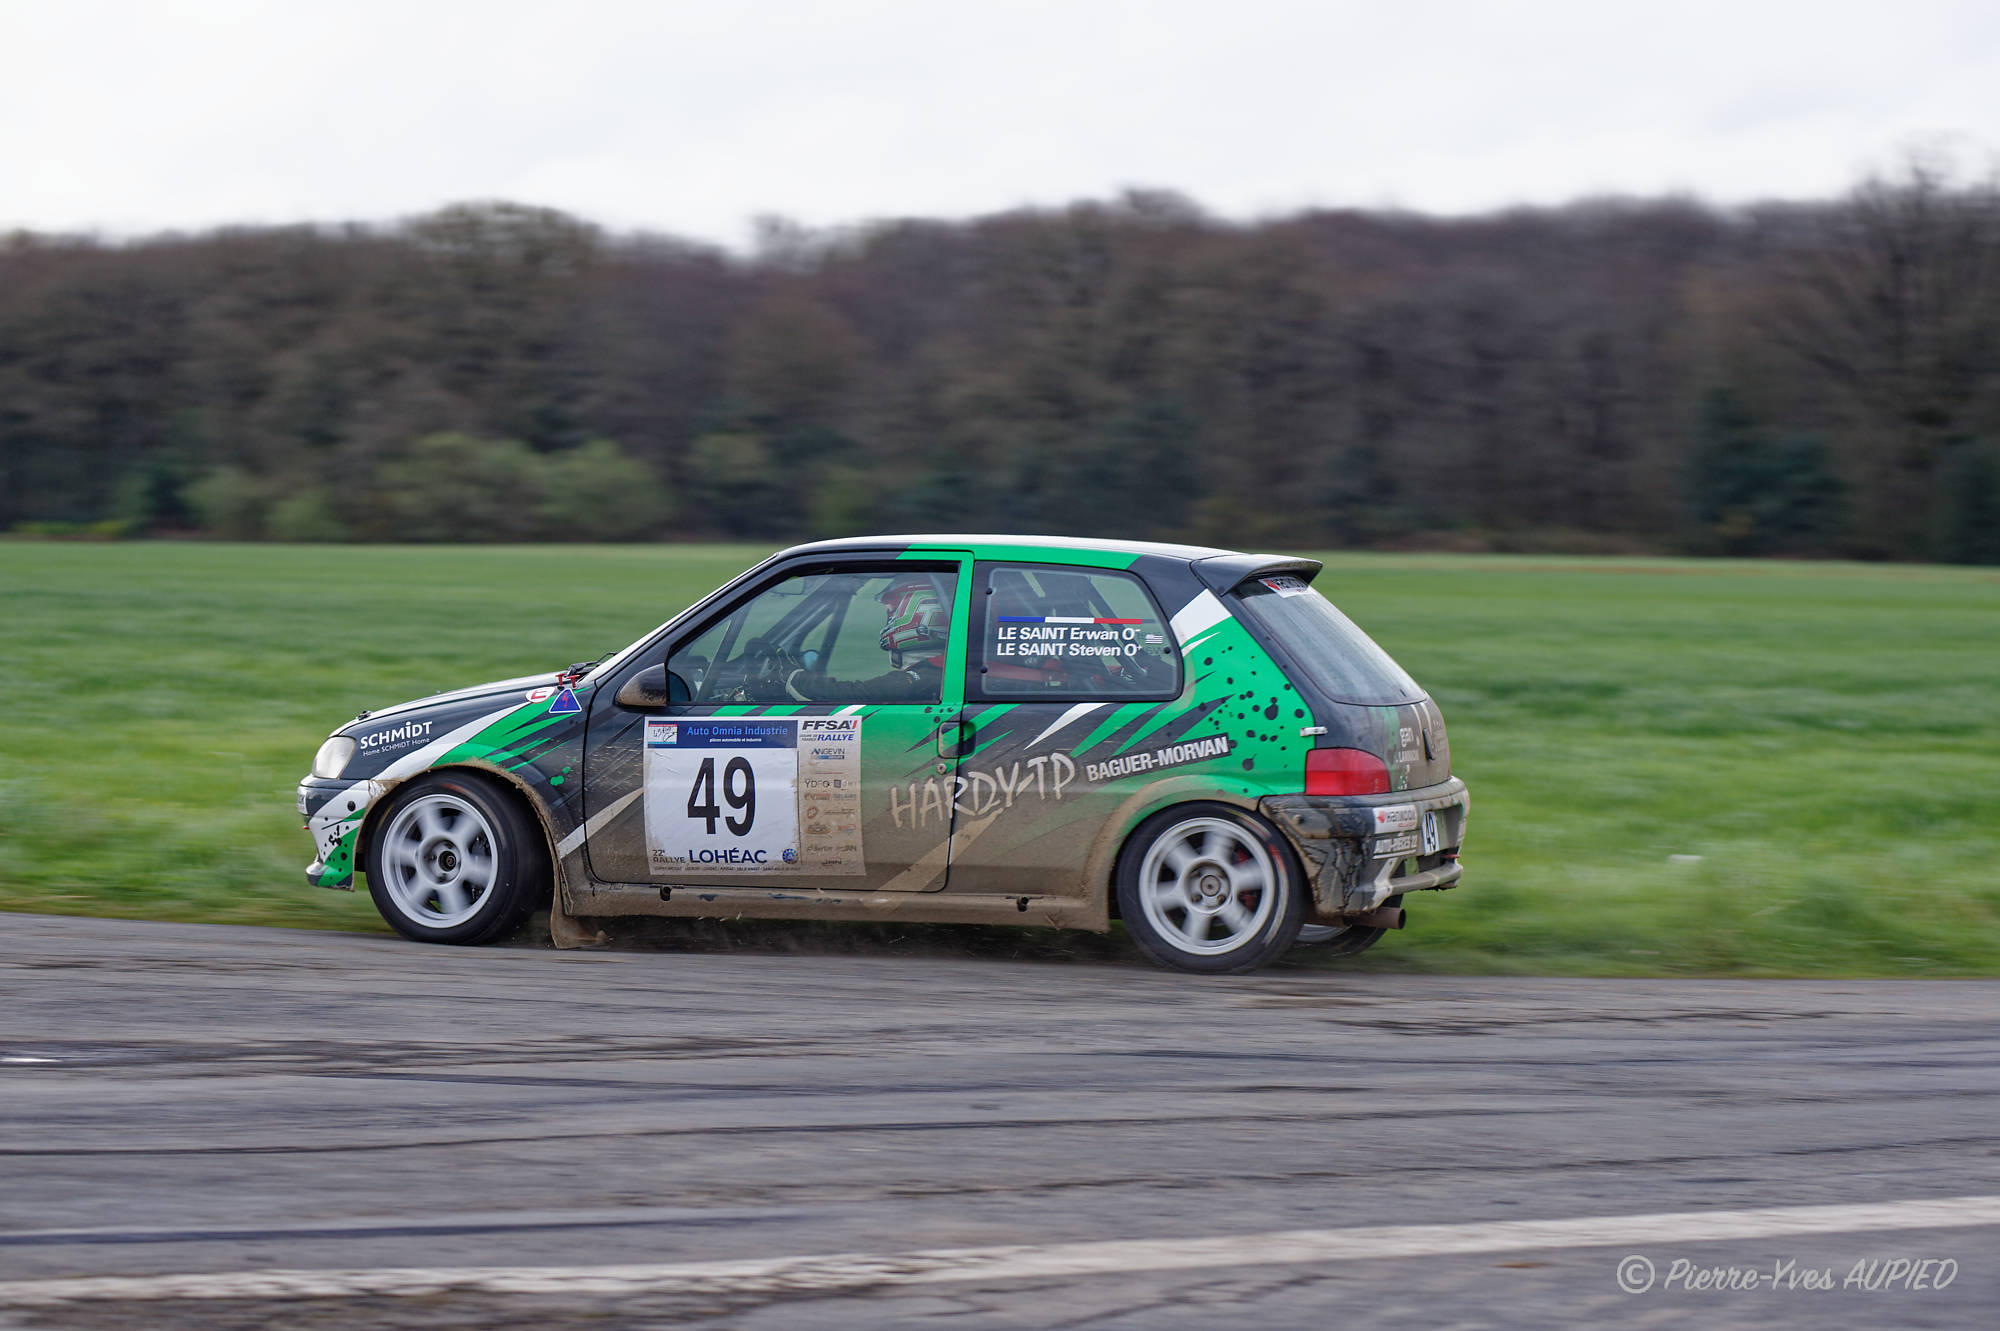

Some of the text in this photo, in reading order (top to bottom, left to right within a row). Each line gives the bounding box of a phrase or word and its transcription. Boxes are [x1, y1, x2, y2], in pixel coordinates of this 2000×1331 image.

[998, 627, 1017, 641] LE
[1020, 627, 1068, 641] SAINT
[1070, 628, 1119, 641] Erwan
[996, 643, 1017, 657] LE
[1019, 643, 1067, 657] SAINT
[1069, 643, 1121, 657] Steven
[687, 726, 710, 736] Auto
[712, 726, 742, 736] Omnia
[744, 726, 788, 736] Industrie
[817, 734, 854, 742] RALLYE
[1086, 736, 1229, 782] BAGUER-MORVAN
[687, 756, 757, 837] 49
[890, 752, 1077, 829] HARDY-TP
[1424, 812, 1437, 852] 49
[652, 856, 686, 864] RALLYE
[689, 847, 767, 864] LOHÉAC
